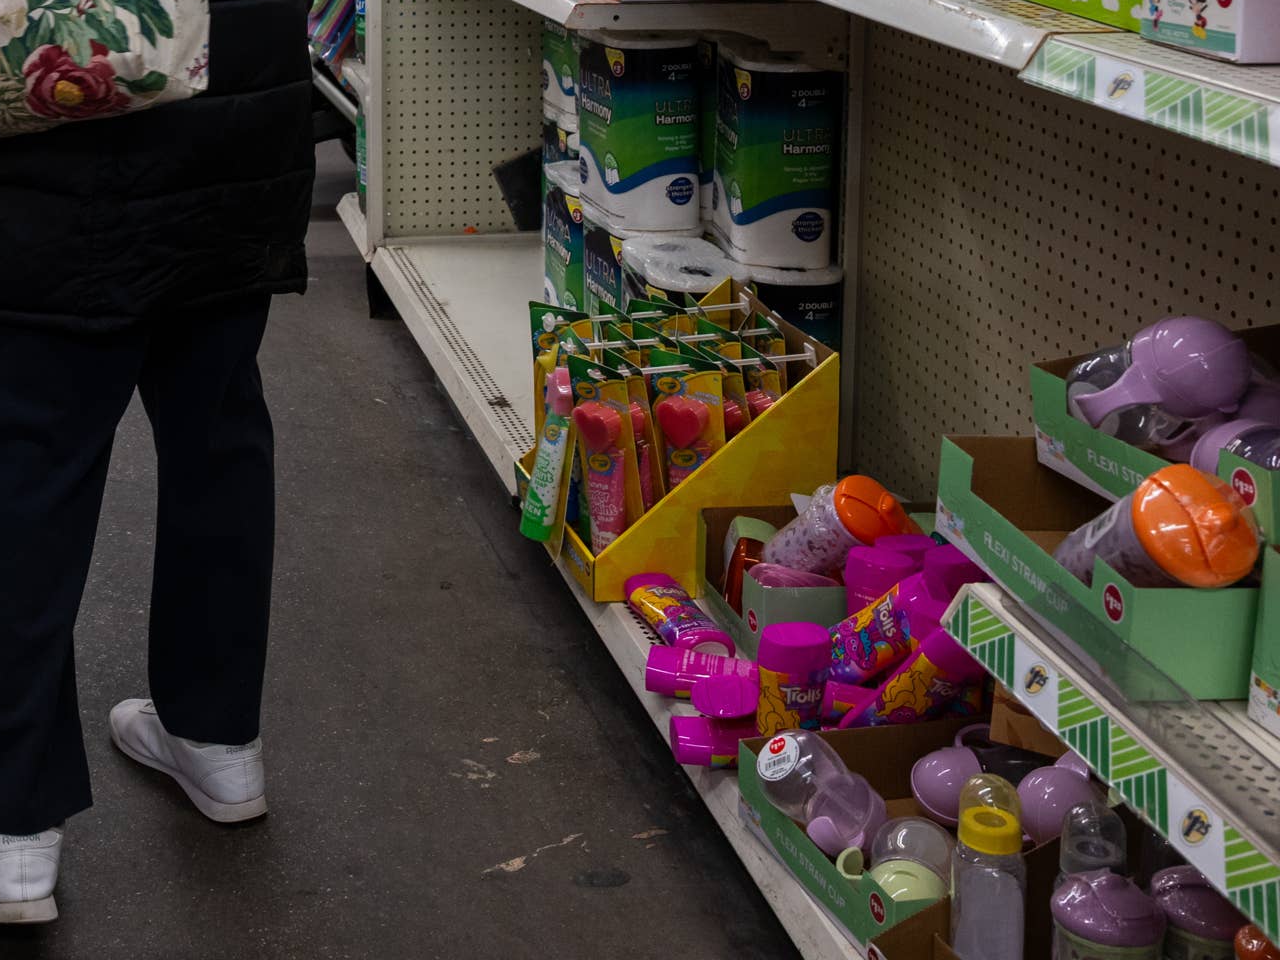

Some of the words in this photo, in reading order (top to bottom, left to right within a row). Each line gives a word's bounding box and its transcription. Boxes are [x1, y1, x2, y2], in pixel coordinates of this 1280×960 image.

[580, 70, 612, 99] ULTRA
[581, 92, 613, 125] Harmony
[585, 249, 617, 288] ULTRA
[1087, 448, 1118, 476] FLEXI
[983, 531, 1010, 565] FLEXI
[1011, 557, 1047, 593] STRAW
[877, 593, 897, 639] Trolls
[780, 685, 822, 705] Trolls
